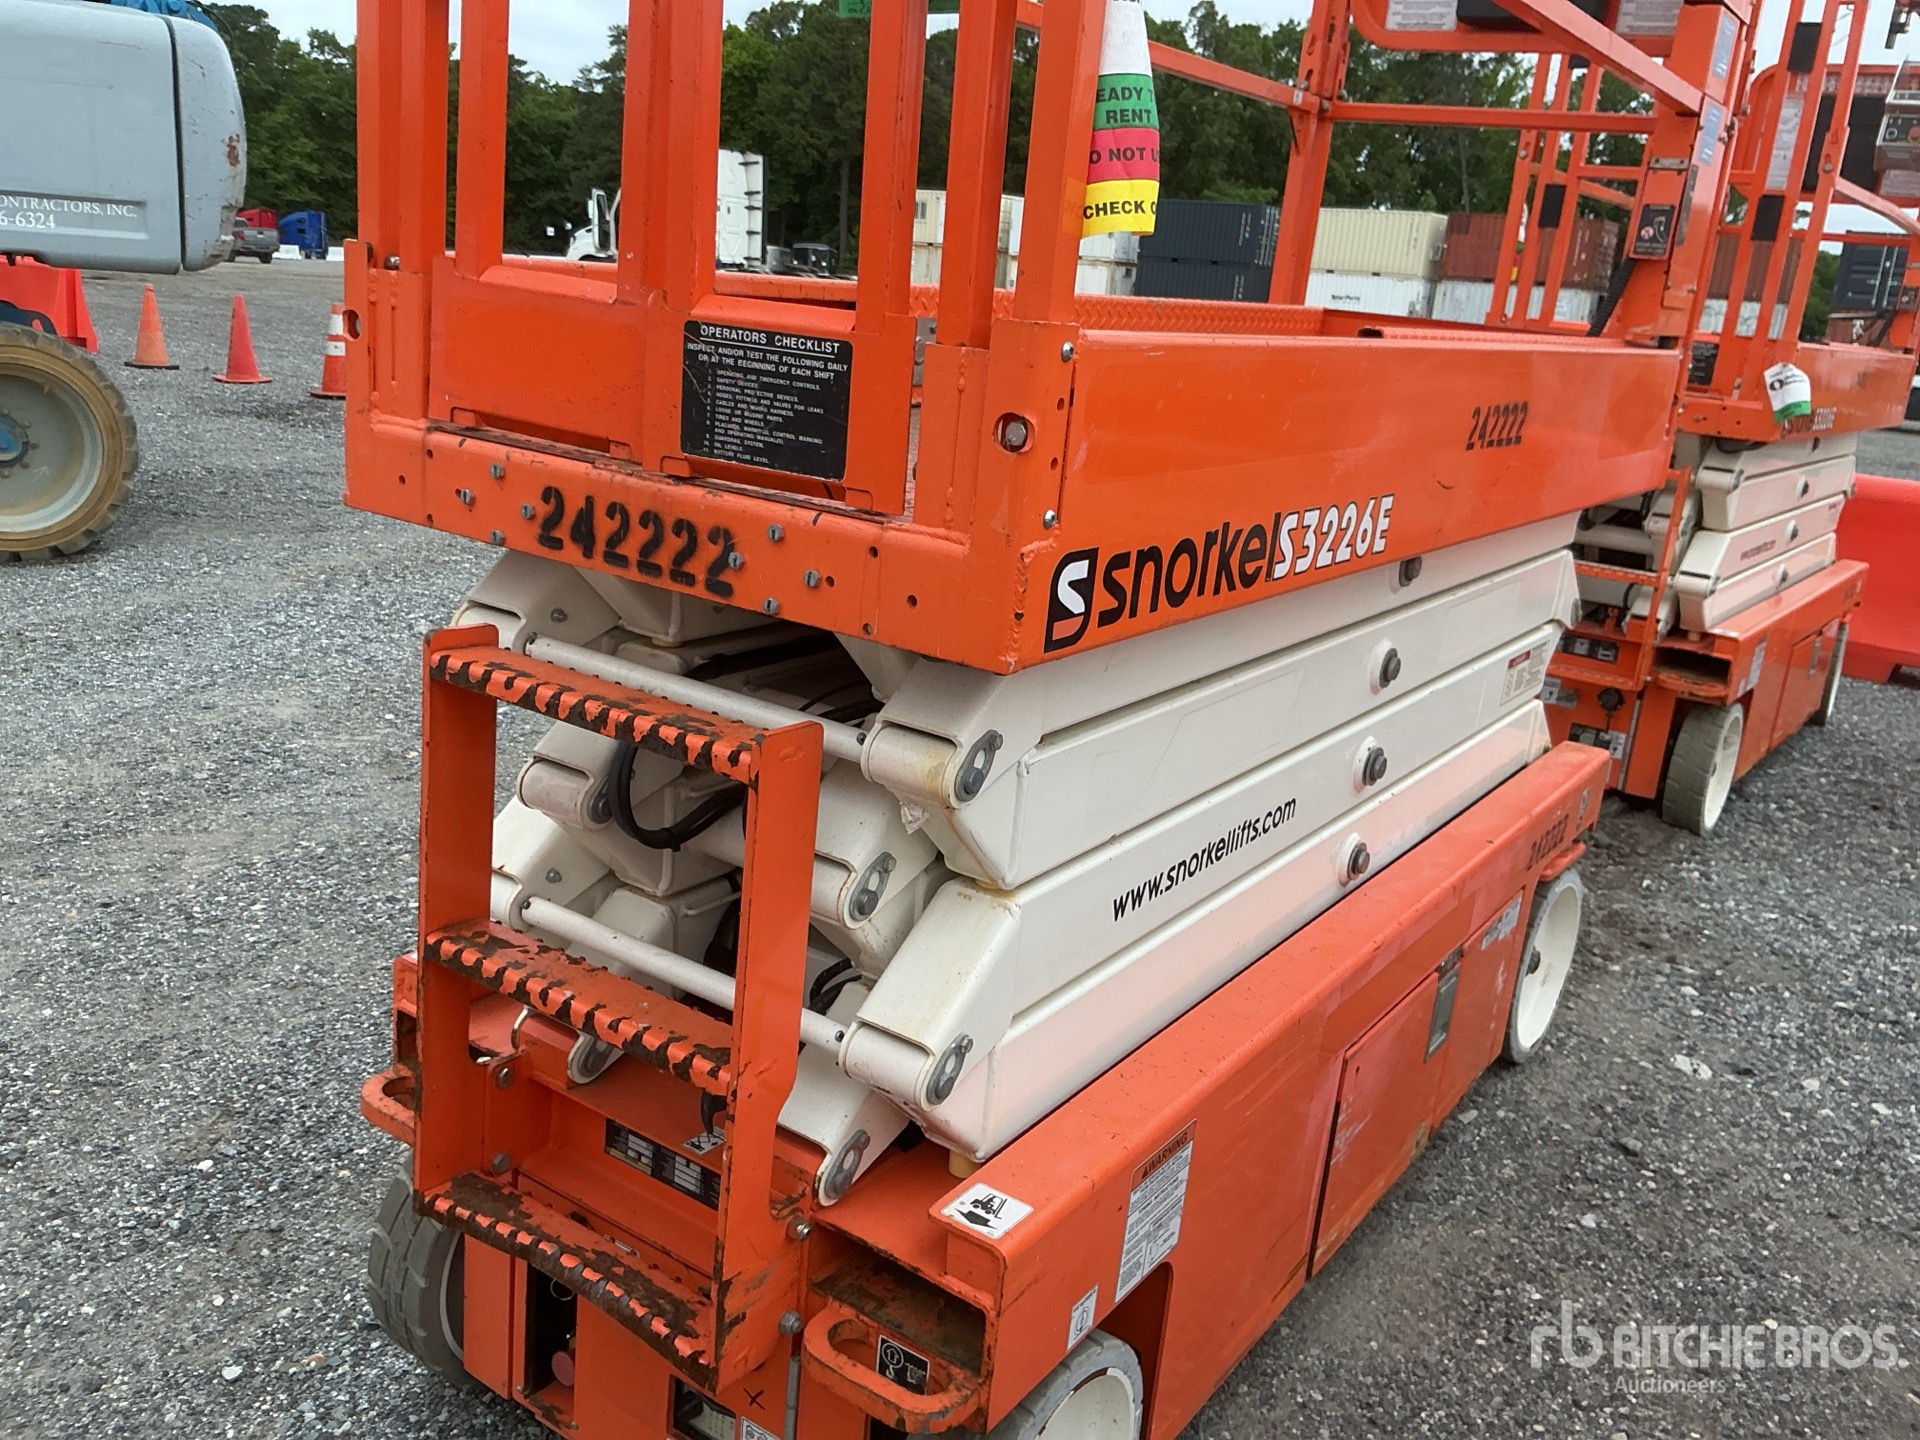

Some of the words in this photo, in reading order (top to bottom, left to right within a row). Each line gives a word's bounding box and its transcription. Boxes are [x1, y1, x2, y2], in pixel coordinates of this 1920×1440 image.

[1096, 86, 1143, 103] EADY
[1105, 108, 1151, 124] RENT
[1089, 149, 1101, 164] O
[1108, 146, 1146, 161] NOT
[0, 195, 104, 216] ONTRACTORS,
[106, 203, 137, 217] INC.
[1083, 200, 1146, 219] CHECK
[0, 210, 55, 229] 6-6324
[700, 325, 767, 344] OPERATORS
[774, 335, 840, 353] CHECKLIST
[687, 343, 715, 352] INSPECT
[718, 347, 744, 357] AND/OR
[746, 350, 764, 359] TEST
[766, 352, 780, 362] THE
[782, 356, 824, 368] FOLLOWING
[828, 362, 848, 372] DAILY
[710, 356, 720, 364] AT
[722, 357, 734, 366] THE
[738, 360, 776, 372] BEGINNING
[778, 365, 788, 373] OF
[792, 367, 810, 376] EACH
[814, 370, 834, 380] SHIFT
[744, 388, 774, 398] PROECTIVE
[792, 381, 821, 390] CONTROLS.
[1466, 401, 1528, 451] 242222
[537, 486, 735, 598] 242222
[1097, 512, 1281, 628] snorkel
[1272, 493, 1395, 581] S3226E
[1113, 797, 1297, 922] www.snorkellifts.com
[1148, 1131, 1187, 1173] WARNING
